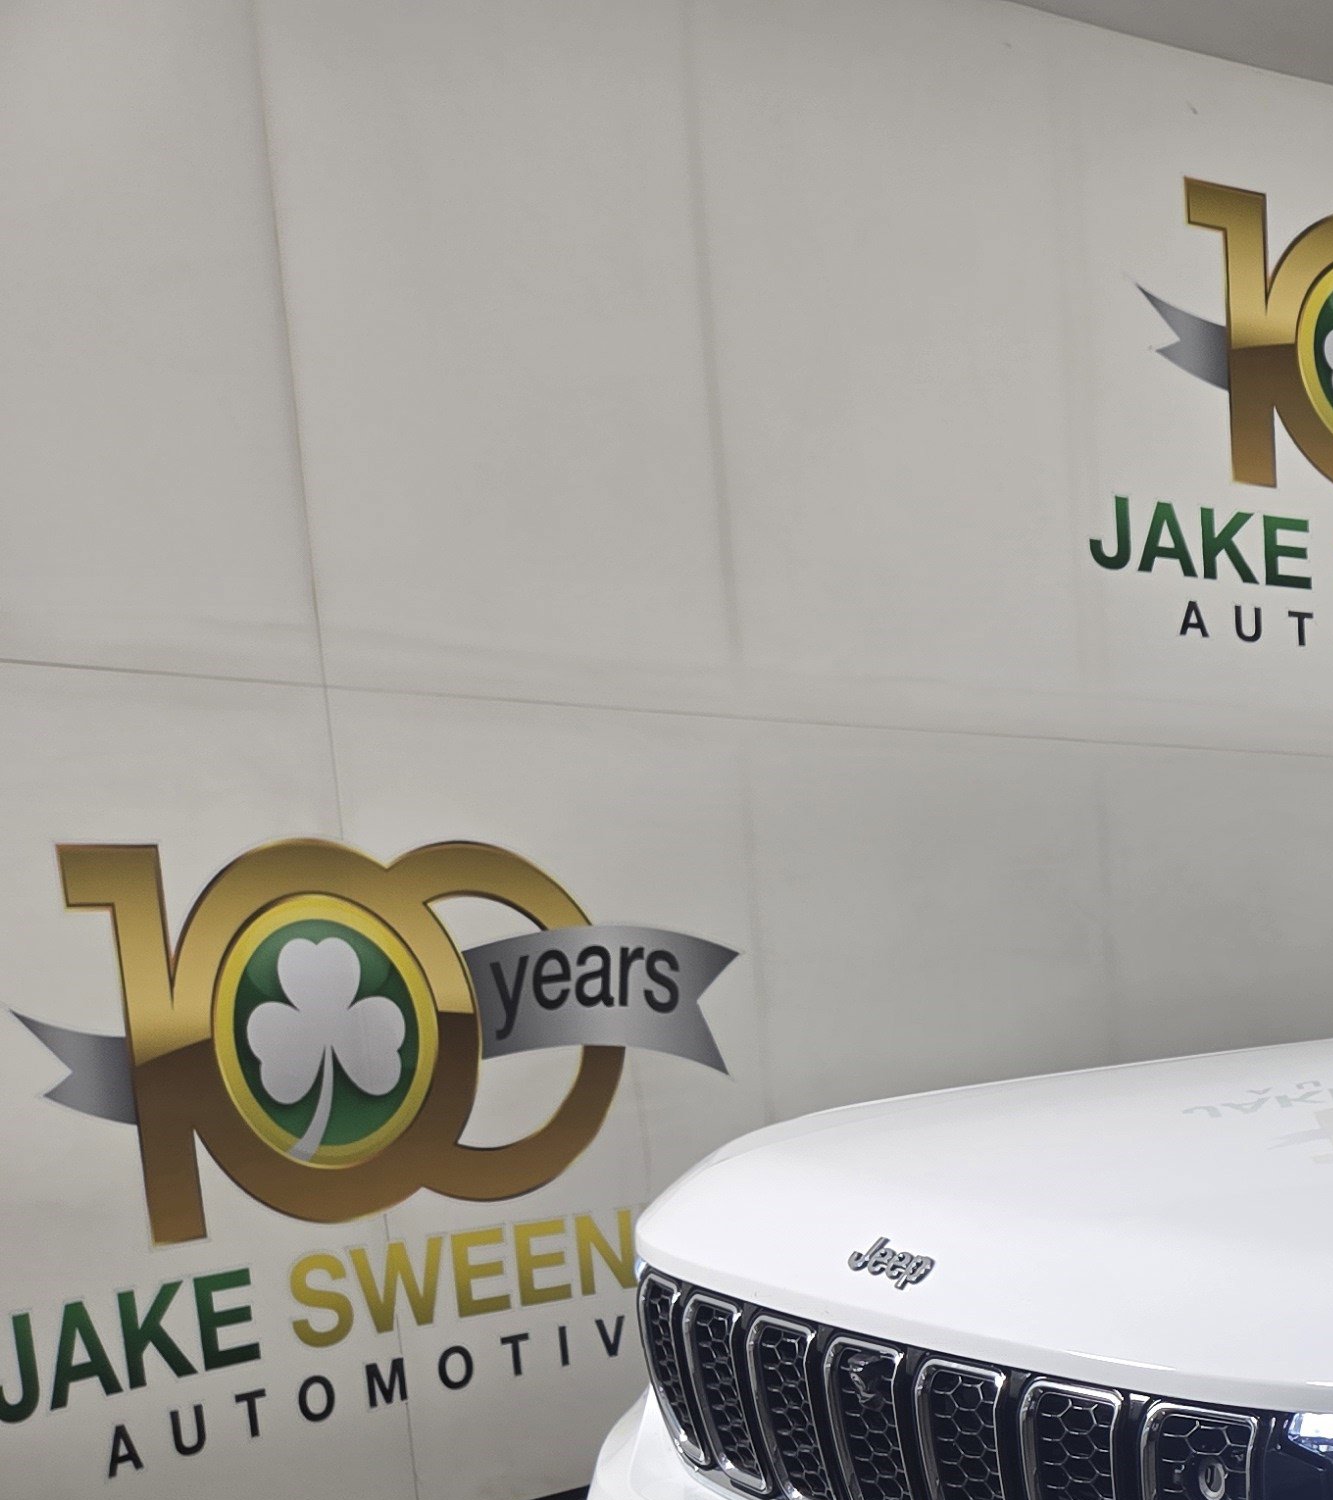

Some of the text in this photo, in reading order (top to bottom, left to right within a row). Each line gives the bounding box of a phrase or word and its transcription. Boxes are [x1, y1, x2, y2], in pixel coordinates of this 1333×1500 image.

[1088, 494, 1313, 590] JAKE
[55, 837, 681, 1247] 100 years
[0, 1208, 637, 1424] JAKE SWEEN
[847, 1235, 936, 1291] Jeep
[108, 1315, 626, 1478] AUTOMOTIV
